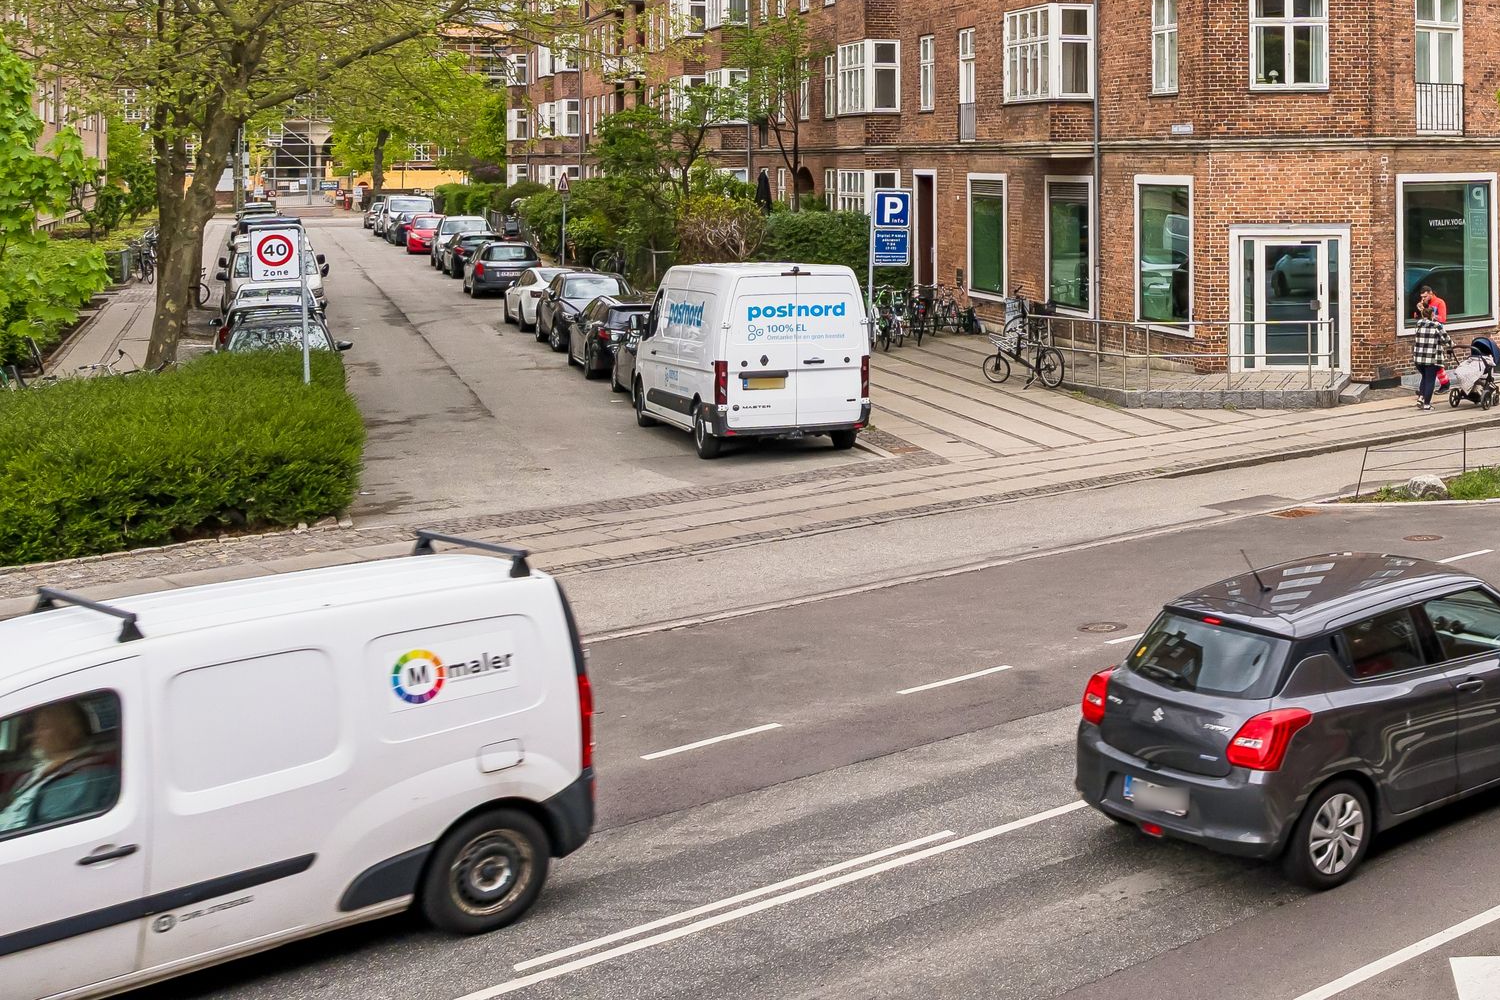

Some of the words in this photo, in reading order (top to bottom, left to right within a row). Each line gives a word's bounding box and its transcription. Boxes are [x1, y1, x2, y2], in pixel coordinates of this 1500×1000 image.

[884, 197, 903, 223] P
[1428, 218, 1466, 227] VITALIV.YOGA
[263, 243, 288, 257] 40
[263, 269, 289, 277] Zone
[747, 301, 846, 322] postnord
[766, 323, 794, 333] 100%
[795, 323, 808, 332] EL
[408, 665, 430, 687] M
[447, 652, 514, 679] maler
